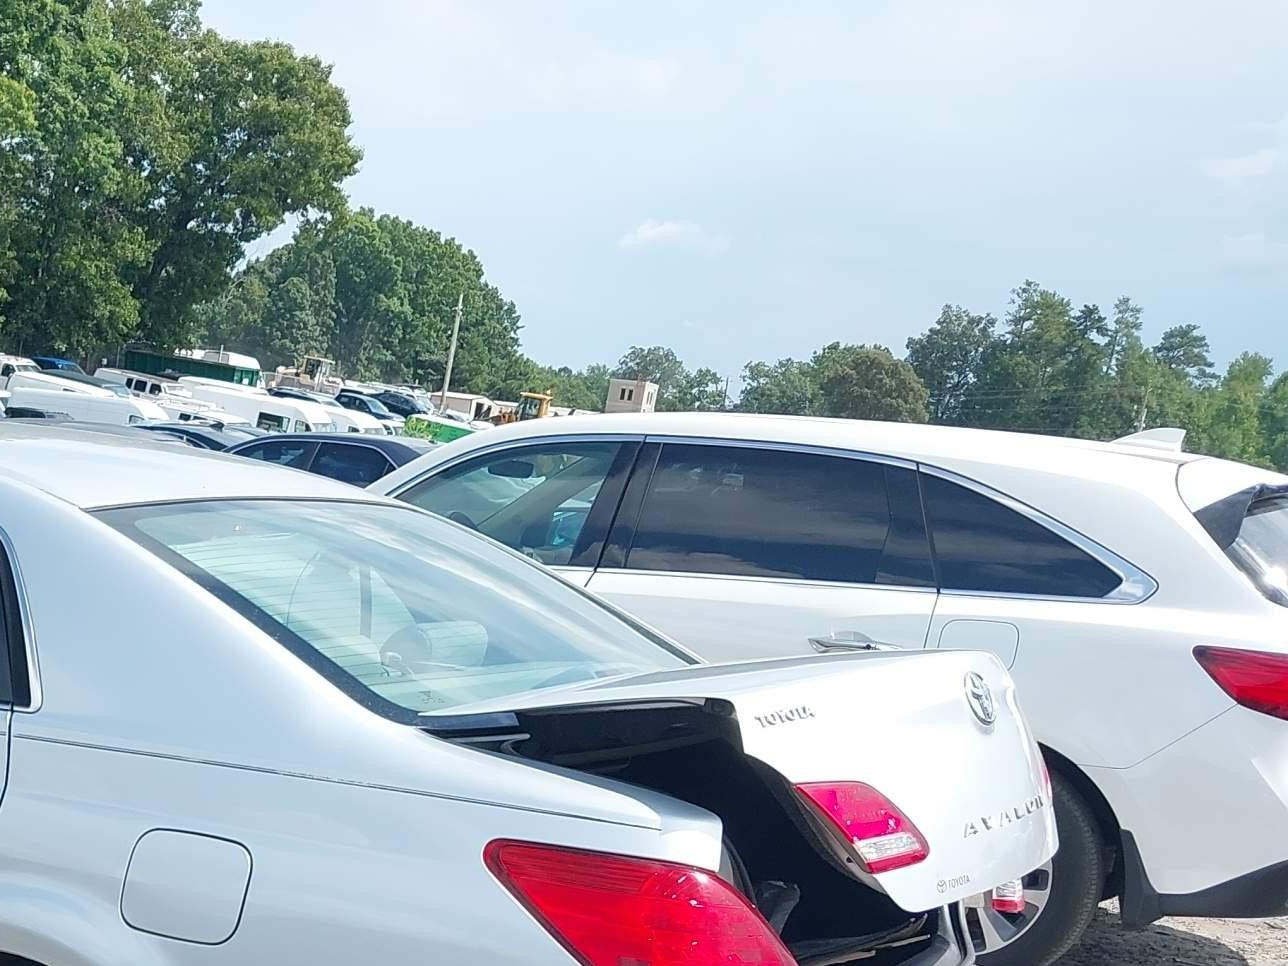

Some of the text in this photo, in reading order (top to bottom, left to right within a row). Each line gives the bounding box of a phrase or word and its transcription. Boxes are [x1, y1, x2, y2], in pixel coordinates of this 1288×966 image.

[753, 706, 815, 728] TOYOTA
[963, 795, 1044, 839] AVALON
[948, 875, 971, 889] TOYOTA
